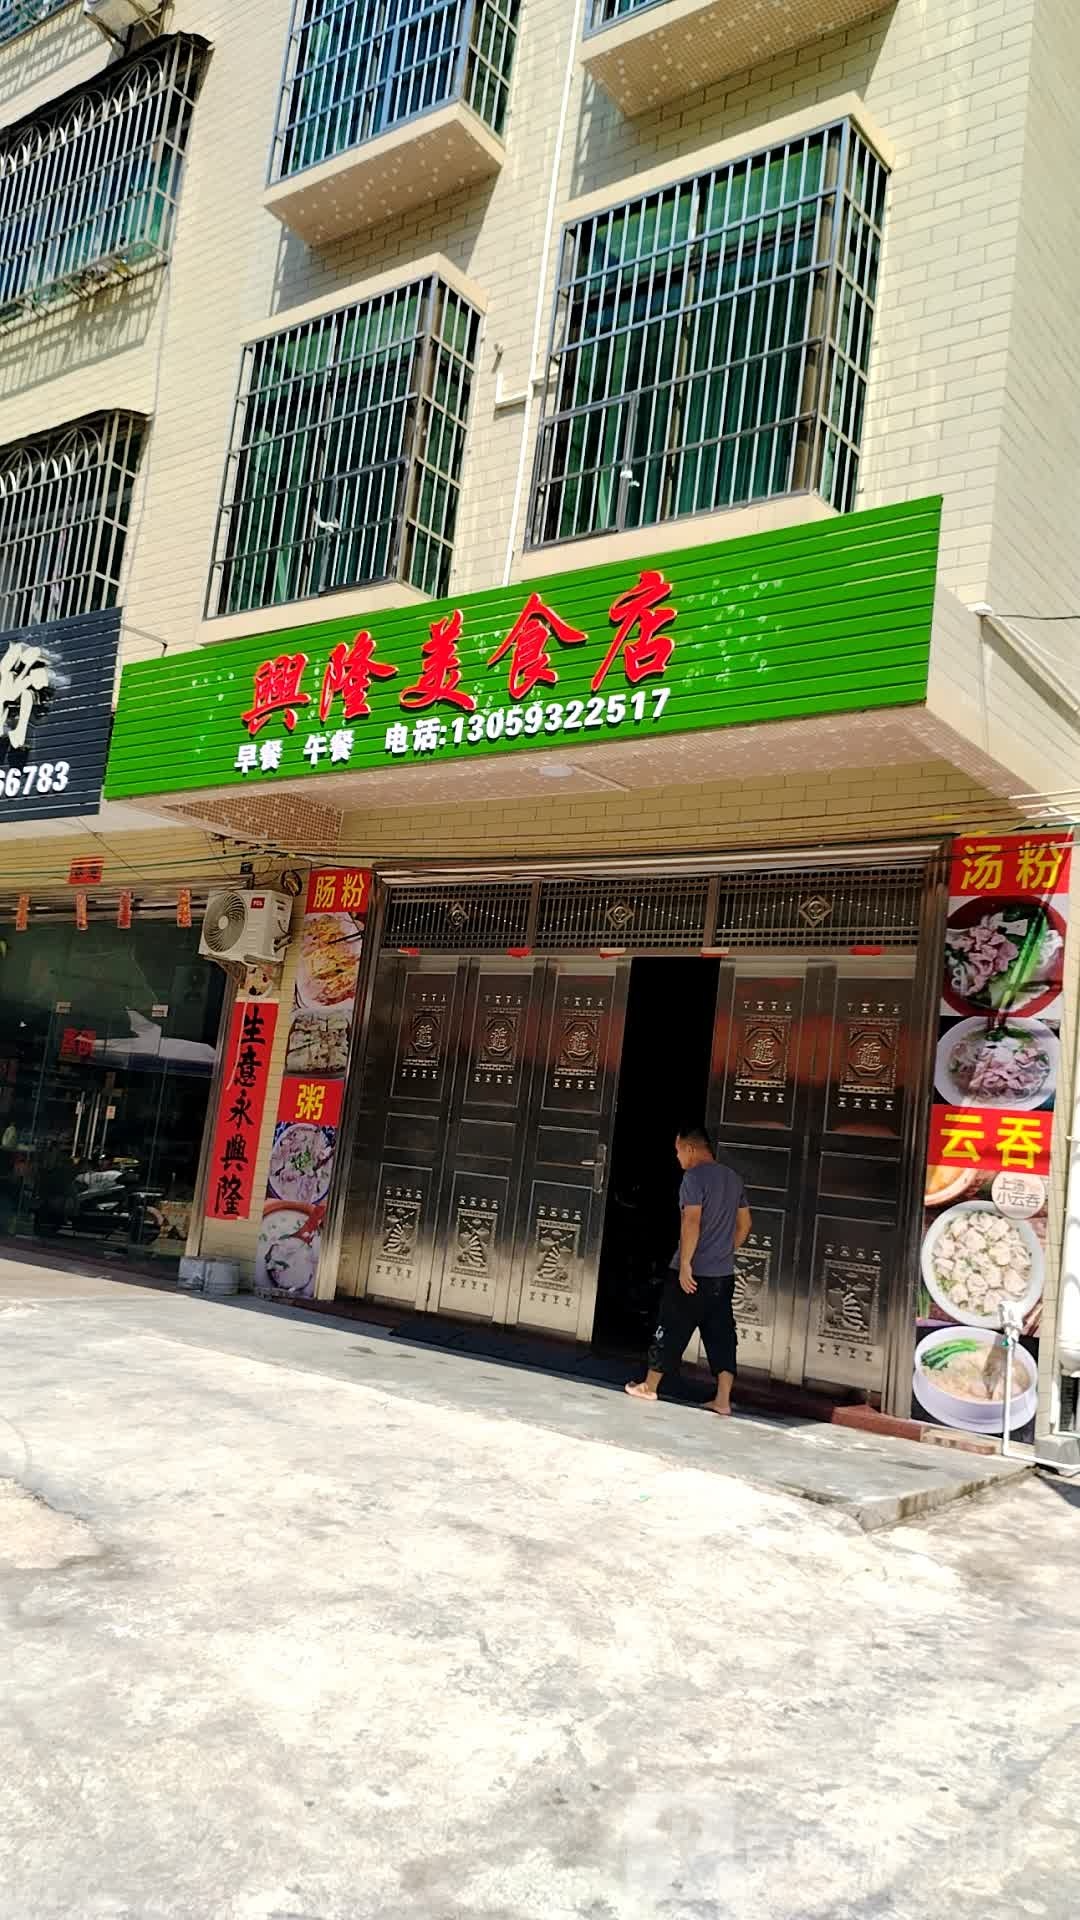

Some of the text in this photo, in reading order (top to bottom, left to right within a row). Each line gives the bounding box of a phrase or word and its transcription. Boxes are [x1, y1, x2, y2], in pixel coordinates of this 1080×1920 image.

[241, 570, 678, 735] 興隆美食店
[234, 688, 671, 774] 早餐 午餐 电话:13059322517
[0, 760, 70, 798] 6783
[312, 872, 365, 908] 肠粉
[961, 841, 1063, 890] 汤粉
[295, 1083, 326, 1120] 粥
[940, 1113, 1043, 1169] 云吞
